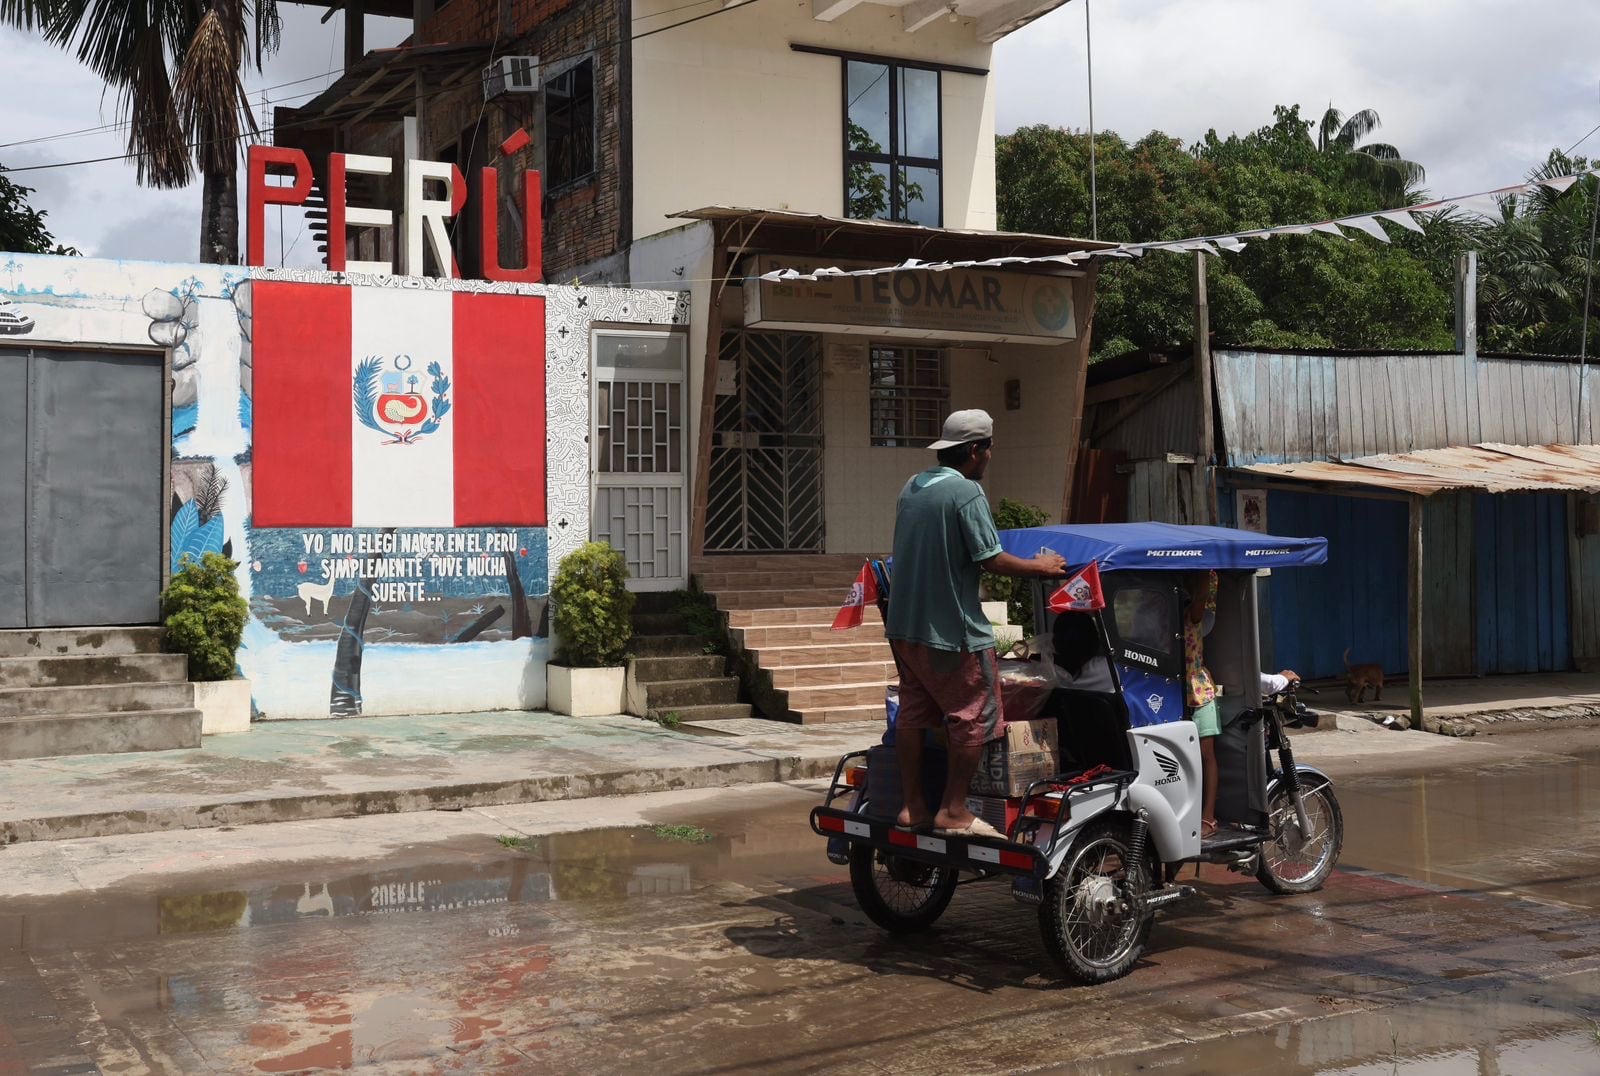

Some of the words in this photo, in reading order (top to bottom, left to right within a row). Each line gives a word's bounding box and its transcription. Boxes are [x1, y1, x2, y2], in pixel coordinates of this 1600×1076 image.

[247, 127, 542, 283] PERÚ
[851, 269, 1006, 312] TEOMAR
[303, 533, 324, 554] YO
[331, 533, 354, 554] NO
[358, 531, 397, 554] ELEGÍ
[401, 533, 445, 553] NACER
[449, 533, 465, 553] EN
[467, 533, 483, 552] EL
[486, 529, 518, 552] PERÚ
[1146, 549, 1203, 557] MOTOKAR
[321, 557, 423, 579] SIMPLEMENTE
[429, 557, 463, 577] TUVE
[467, 556, 508, 576] MUCHA
[1124, 649, 1159, 667] HONDA
[1154, 776, 1181, 786] HONDA
[1012, 889, 1041, 901] HONDA
